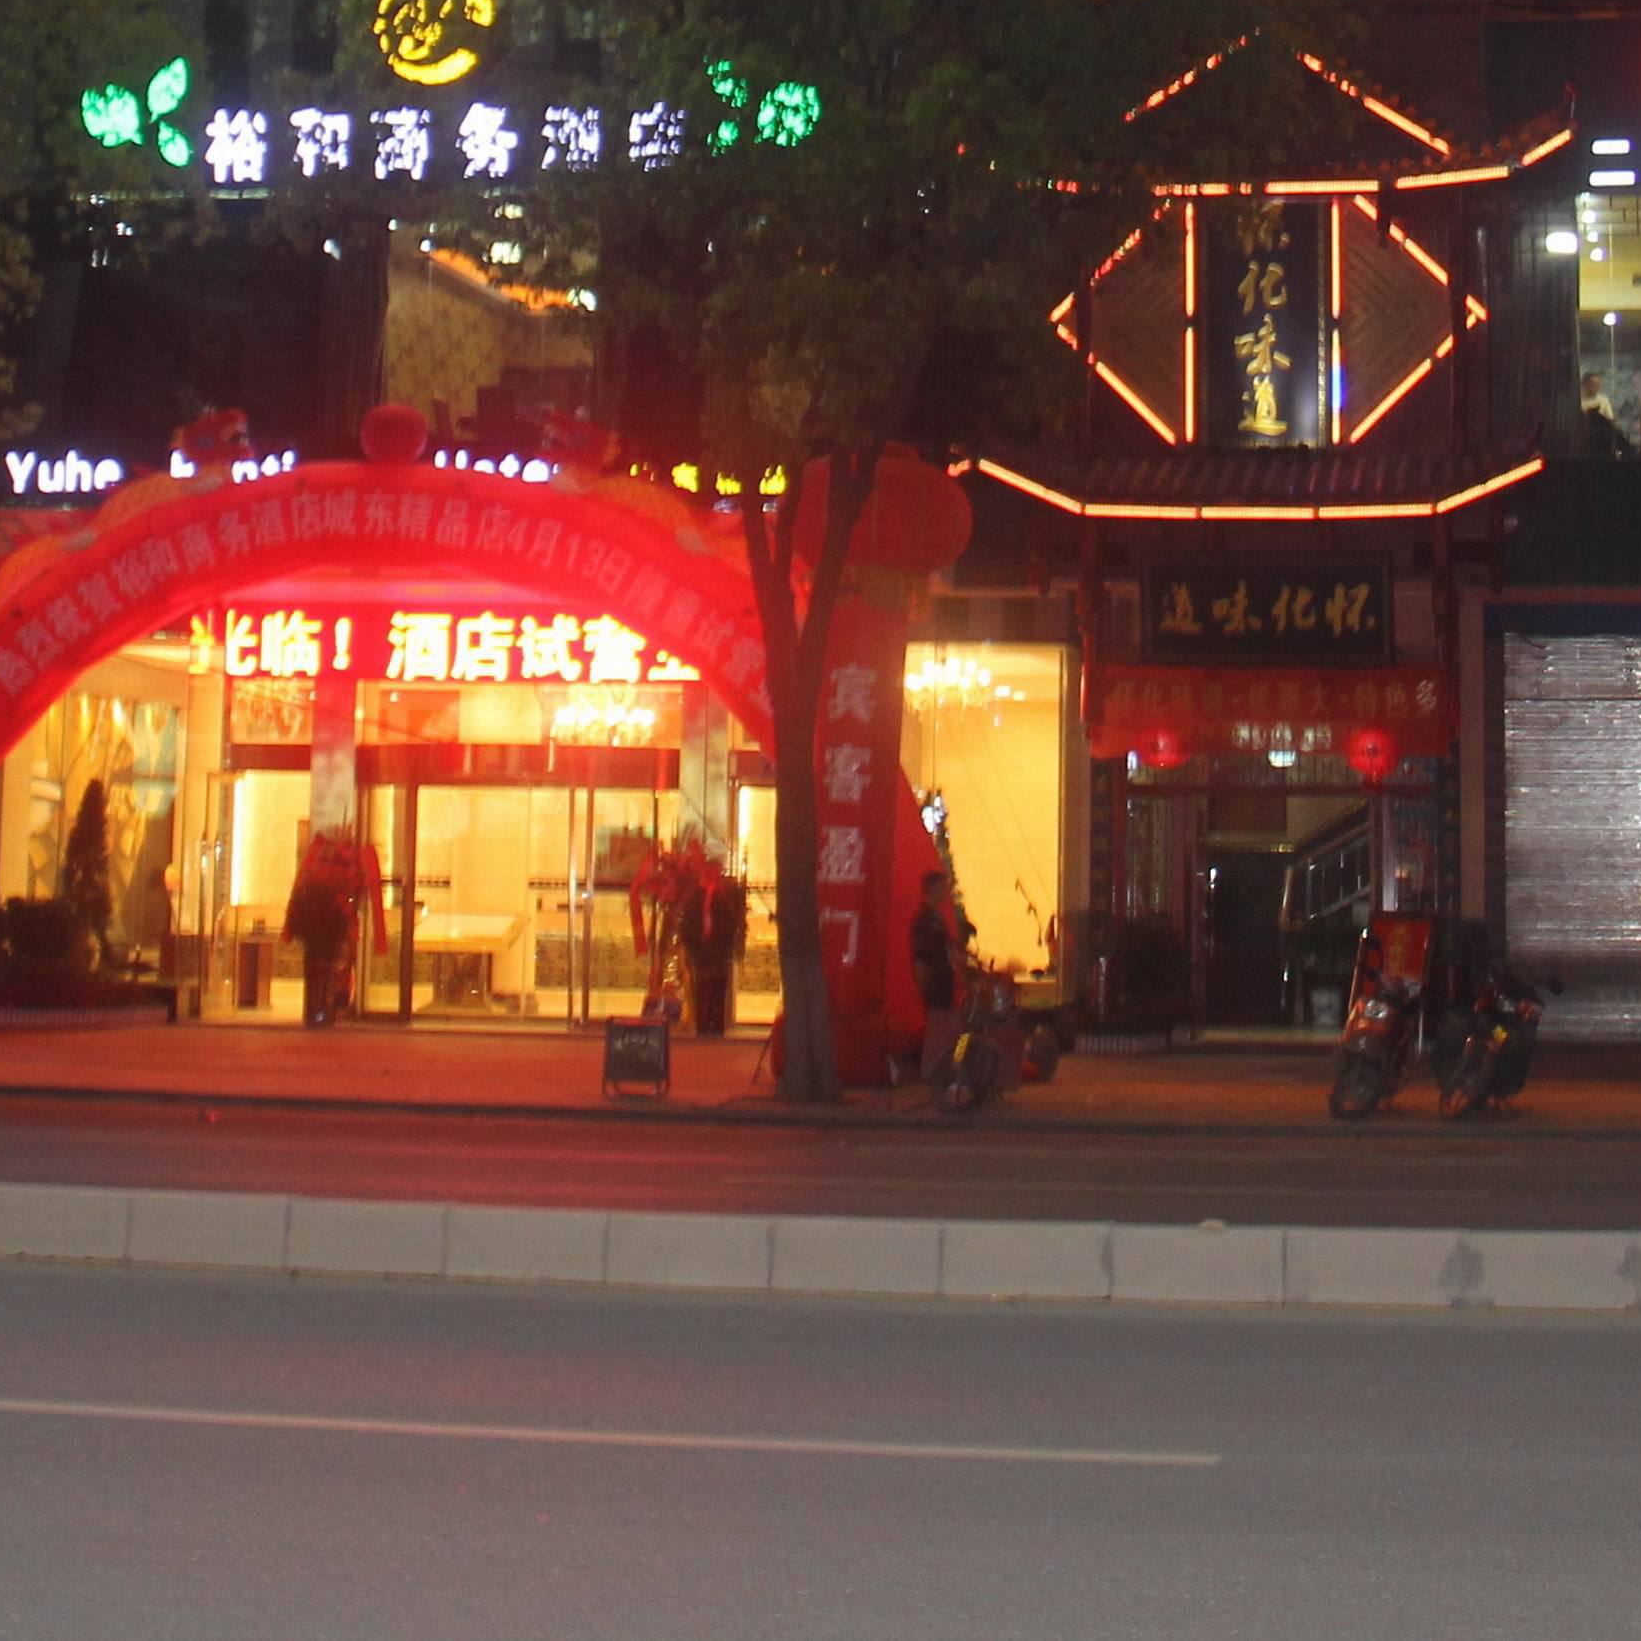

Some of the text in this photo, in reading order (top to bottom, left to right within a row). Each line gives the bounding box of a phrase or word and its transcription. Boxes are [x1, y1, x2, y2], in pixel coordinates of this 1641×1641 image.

[204, 101, 684, 182] 裕和商务酒店
[1233, 200, 1292, 436] 怀化味道
[5, 449, 123, 494] Yuhe
[817, 661, 878, 965] 宾客盈门
